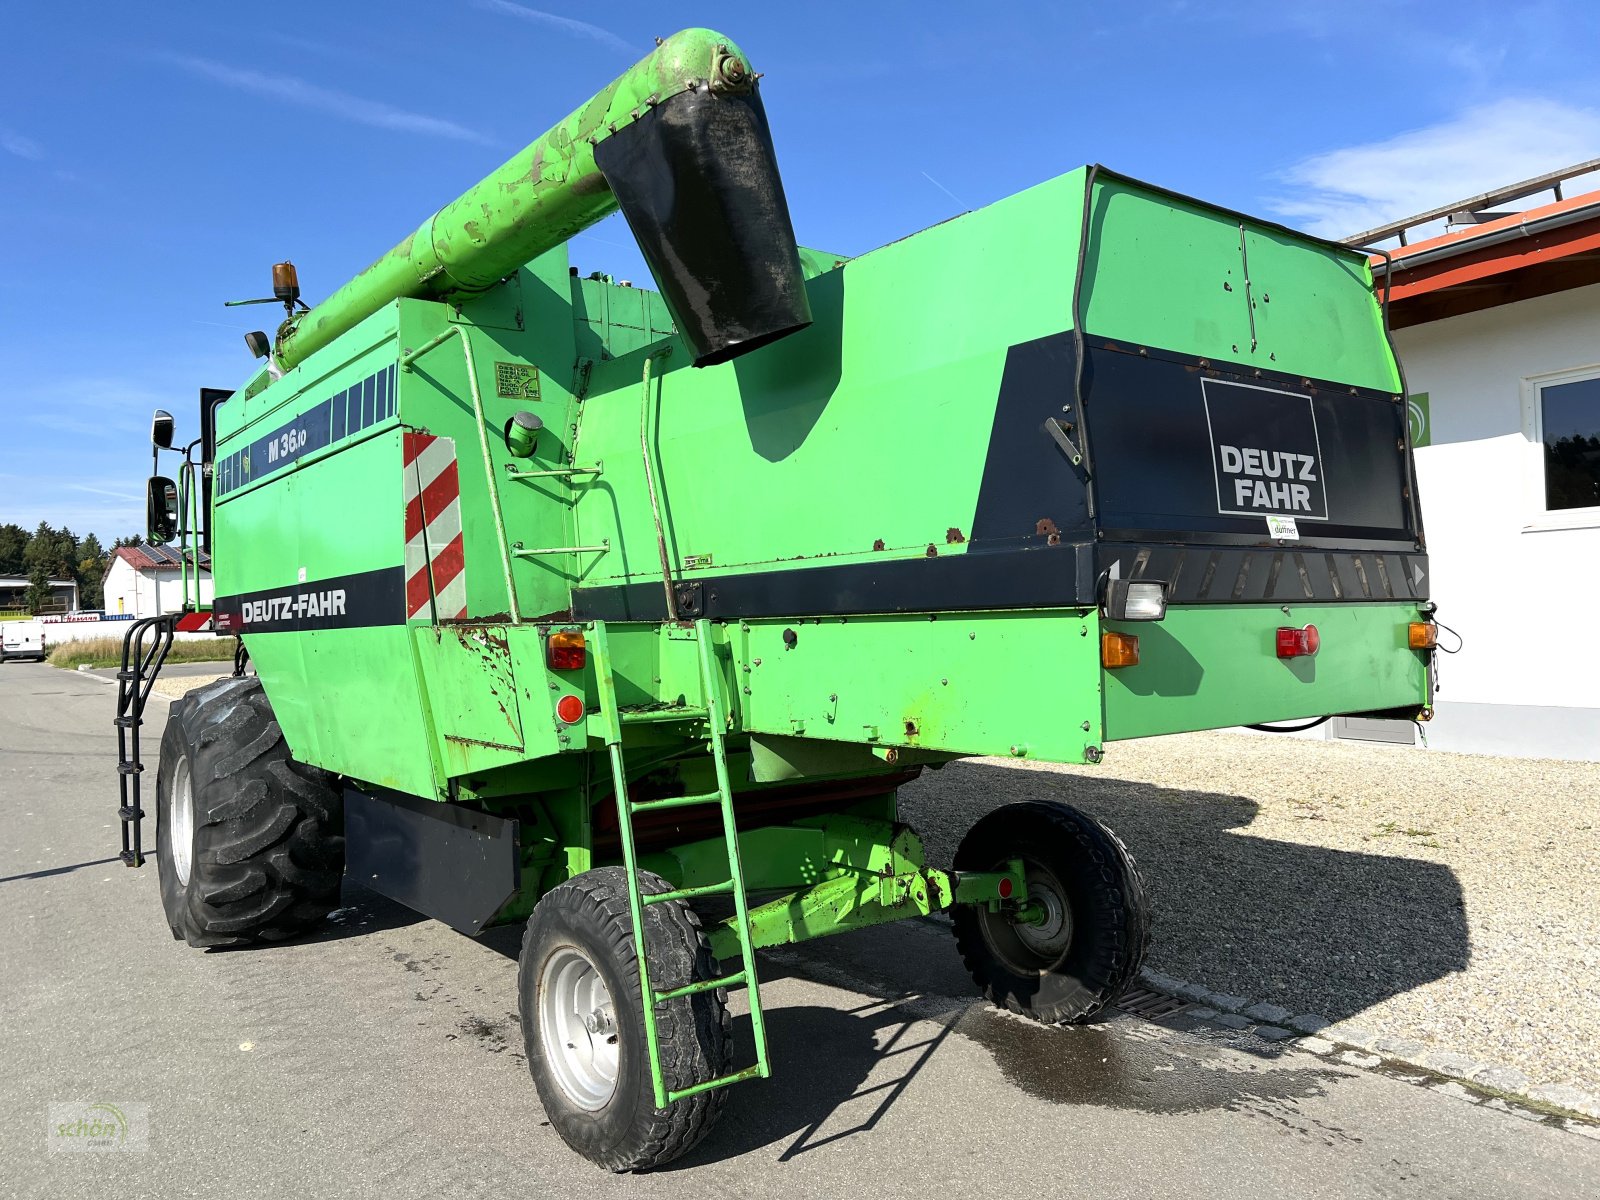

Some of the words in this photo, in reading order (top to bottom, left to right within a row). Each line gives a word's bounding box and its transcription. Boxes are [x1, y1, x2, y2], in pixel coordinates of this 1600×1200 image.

[268, 440, 279, 464] M
[280, 428, 307, 458] 36.10
[1220, 444, 1317, 482] DEUTZ
[1234, 478, 1312, 512] FAHR
[241, 589, 347, 624] DEUTZ-FAHR
